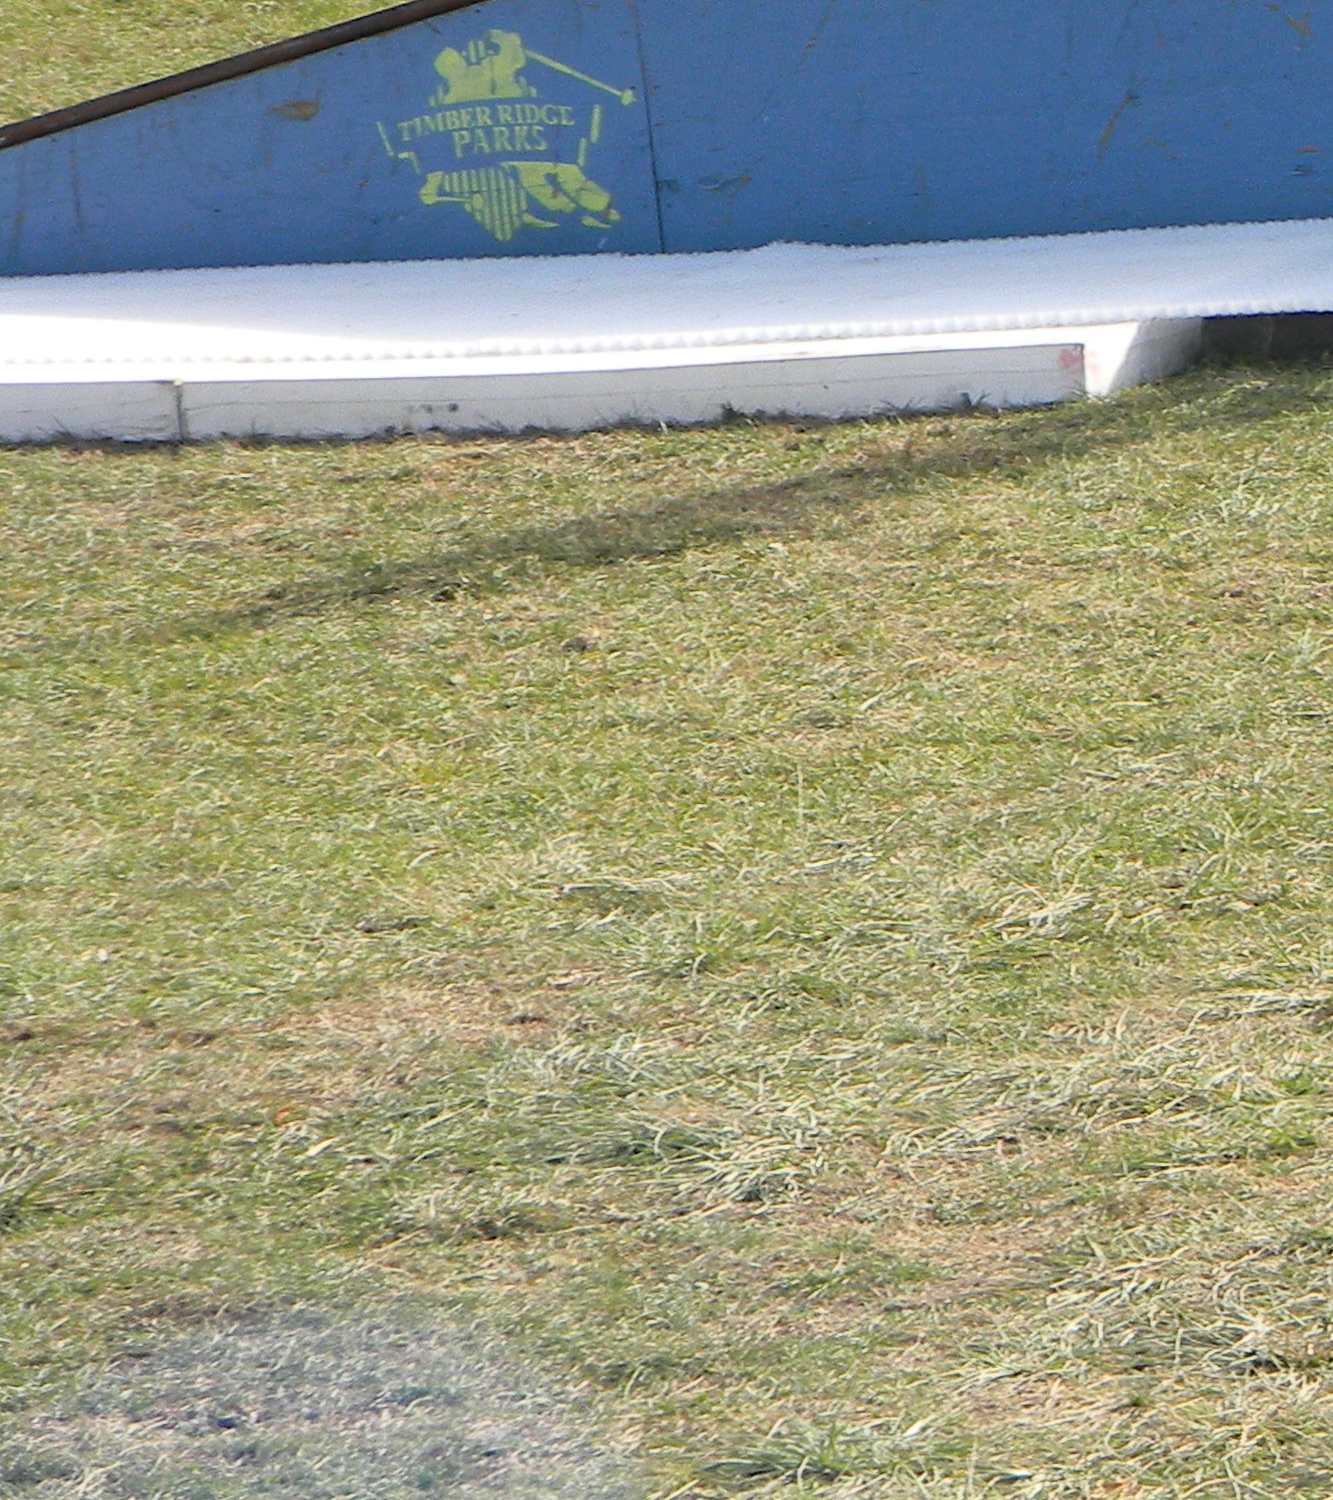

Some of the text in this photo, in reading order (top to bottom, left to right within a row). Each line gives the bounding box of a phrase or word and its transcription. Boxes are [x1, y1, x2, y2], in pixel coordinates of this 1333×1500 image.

[397, 103, 576, 141] TIMBER RIDGE
[452, 125, 549, 159] PARKS
